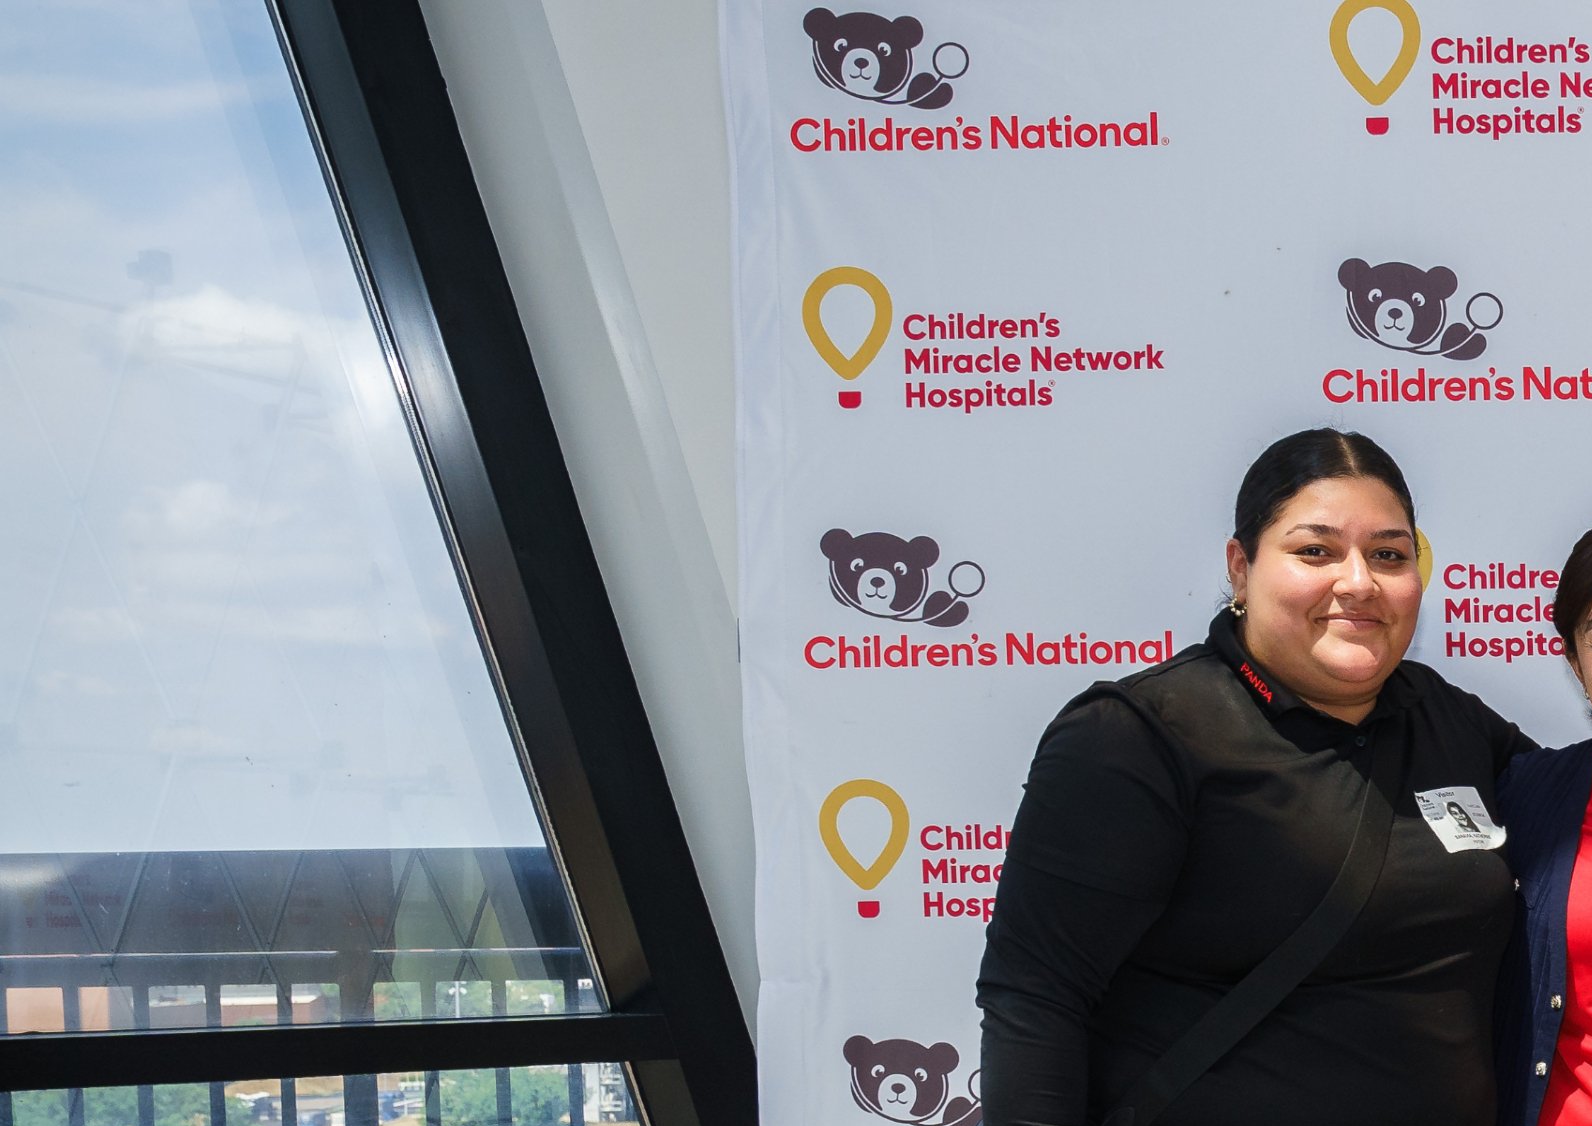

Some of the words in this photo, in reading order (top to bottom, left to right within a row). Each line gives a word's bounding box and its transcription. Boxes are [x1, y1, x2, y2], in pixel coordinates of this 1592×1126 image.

[1430, 35, 1590, 65] Children's
[1432, 71, 1551, 100] Miracle
[789, 115, 983, 153] Children's
[990, 111, 1159, 150] National
[1432, 105, 1582, 140] Hospitals
[902, 312, 1060, 341] Children's
[904, 346, 1021, 374] Miracle
[1030, 344, 1164, 372] Network
[905, 379, 1054, 413] Hospitals
[1321, 367, 1516, 404] Children's
[1443, 561, 1560, 590] Childre
[803, 633, 998, 670] Children's
[1005, 629, 1174, 666] National
[1445, 629, 1565, 664] Hospita
[1240, 661, 1273, 703] PANDA
